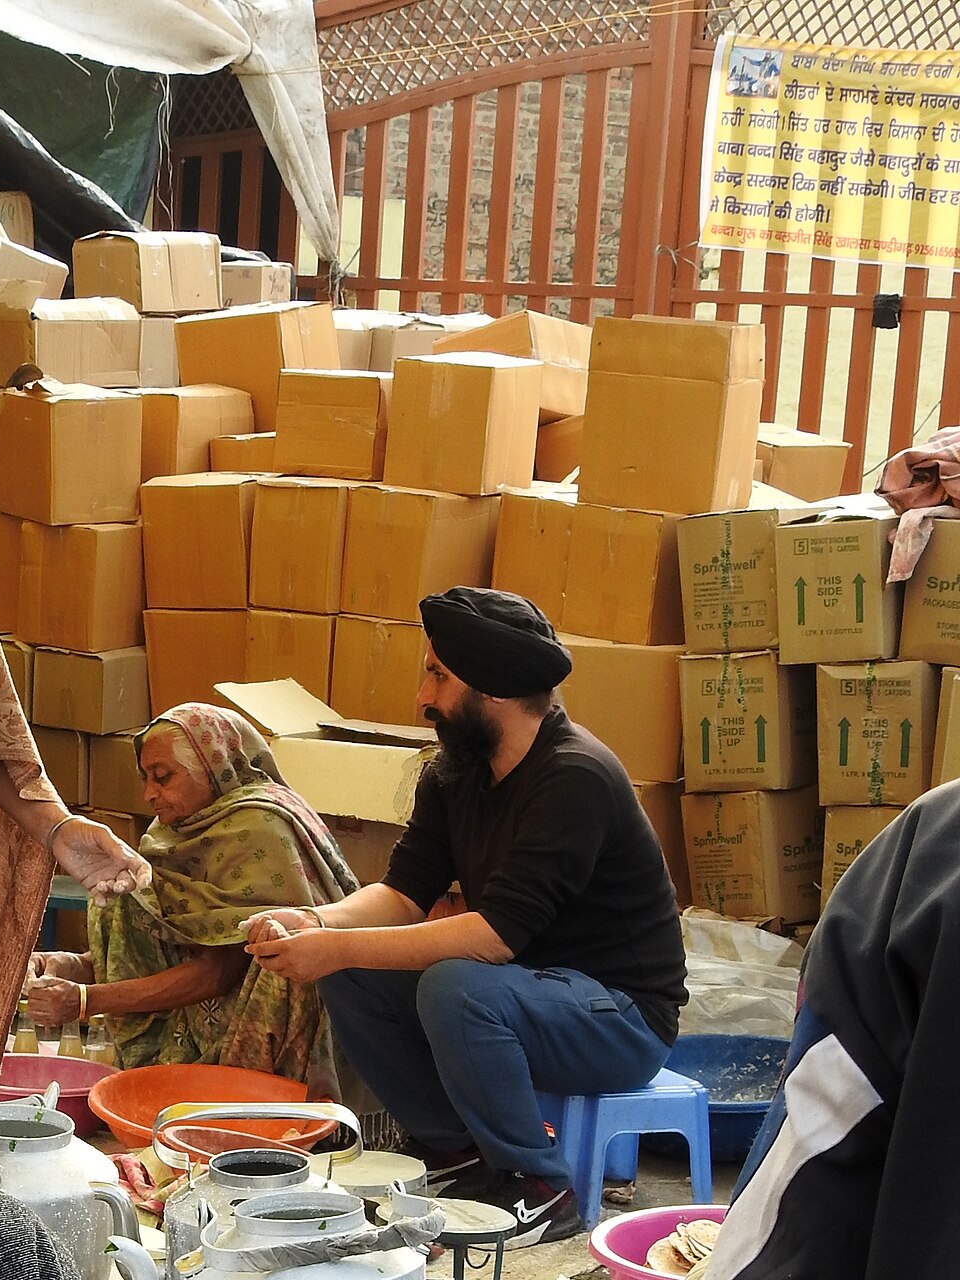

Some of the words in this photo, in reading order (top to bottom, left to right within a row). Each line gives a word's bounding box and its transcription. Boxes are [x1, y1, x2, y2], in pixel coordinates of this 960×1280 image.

[944, 160, 960, 173] सा
[747, 173, 790, 190] सरकार
[898, 181, 927, 202] जीत
[929, 189, 948, 203] हर
[950, 190, 960, 205] ह
[774, 201, 792, 220] की
[797, 540, 806, 553] 5
[816, 575, 842, 585] THIS
[817, 586, 843, 597] SIDE
[823, 598, 839, 608] UP
[704, 681, 713, 693] 5
[844, 681, 853, 693] 5
[721, 717, 745, 726] THIS
[862, 718, 888, 728] THIS
[722, 727, 746, 737] SIDE
[726, 738, 741, 747] UP
